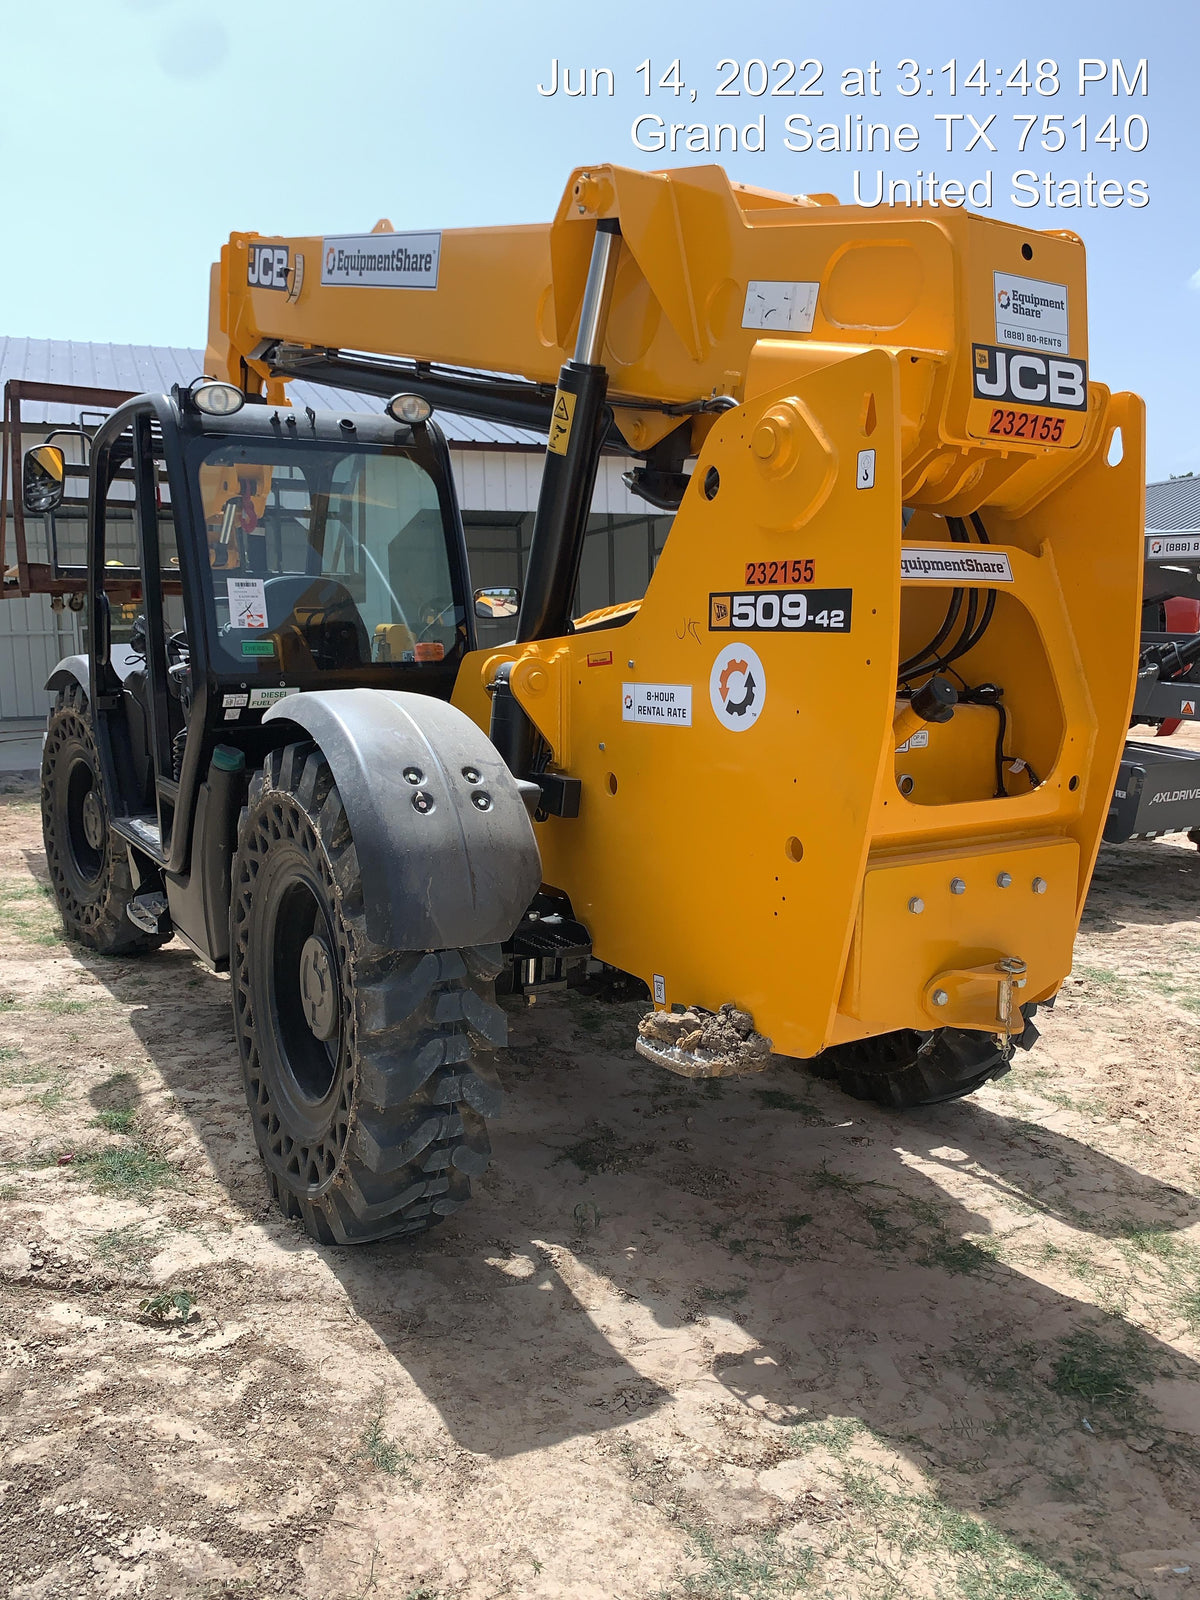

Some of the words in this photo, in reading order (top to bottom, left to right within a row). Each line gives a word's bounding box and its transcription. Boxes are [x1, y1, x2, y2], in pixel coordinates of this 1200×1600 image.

[248, 249, 288, 287] JCB
[337, 248, 432, 276] EquipmentShare
[1012, 290, 1065, 311] Equipment
[1012, 304, 1041, 318] Share
[1004, 329, 1025, 342] (888)
[1026, 332, 1062, 347] 80-RENTS
[976, 352, 1084, 406] JCB
[990, 409, 1065, 441] 232155
[1166, 542, 1190, 552] (888)
[746, 560, 814, 584] 232155
[731, 594, 844, 628] 509-42
[646, 691, 675, 702] 8-HOUR
[637, 705, 665, 717] RENTAL
[667, 707, 687, 718] RATE
